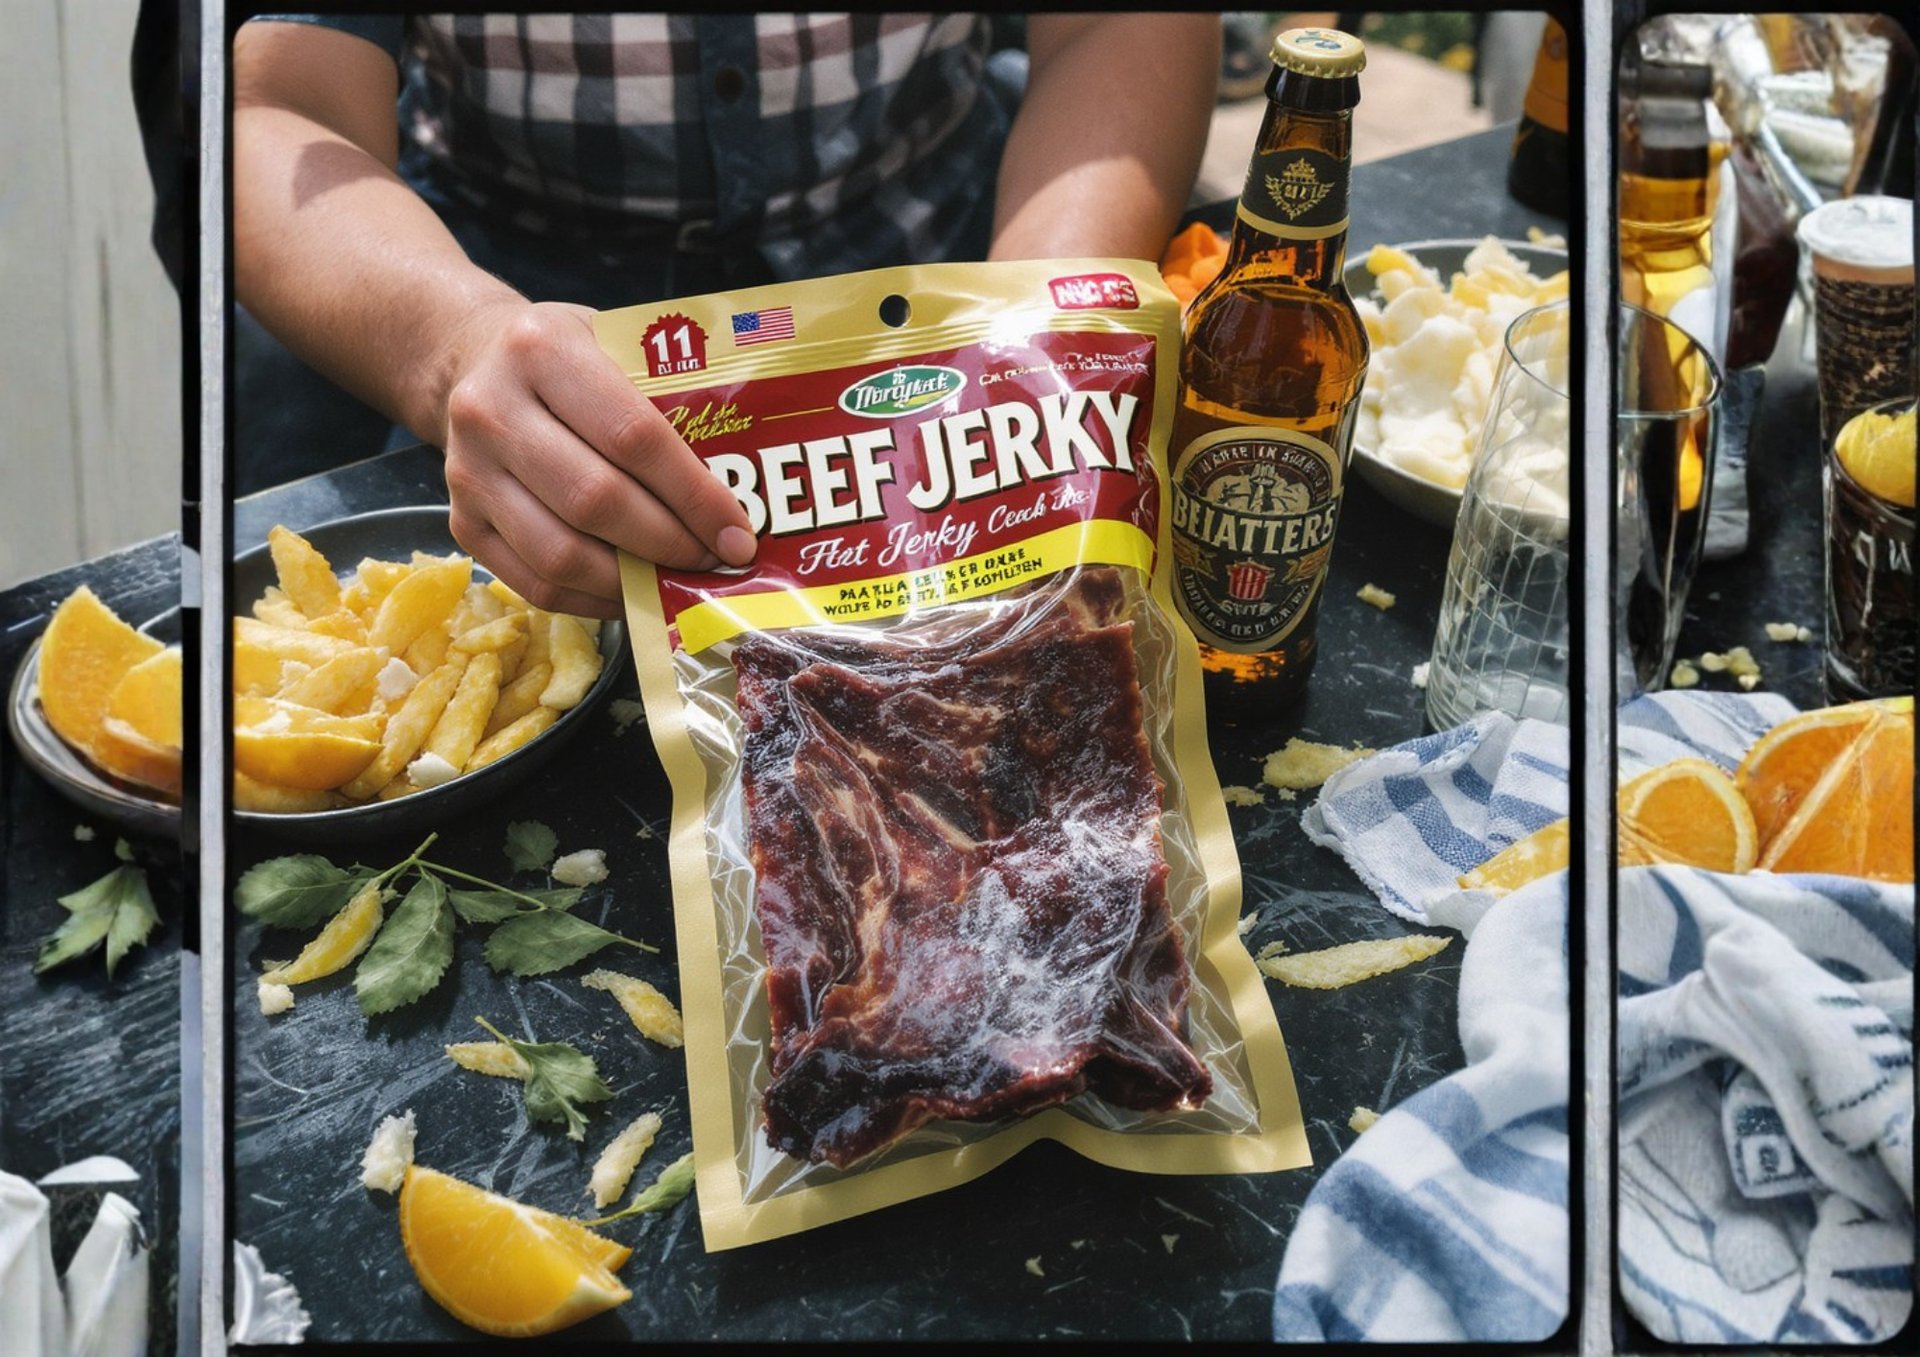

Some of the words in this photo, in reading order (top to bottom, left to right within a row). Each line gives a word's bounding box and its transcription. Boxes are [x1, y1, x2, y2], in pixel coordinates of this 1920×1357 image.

[651, 325, 692, 362] 11
[703, 427, 897, 538] BEEF
[905, 391, 1139, 513] JERKY
[877, 513, 979, 568] Jerky
